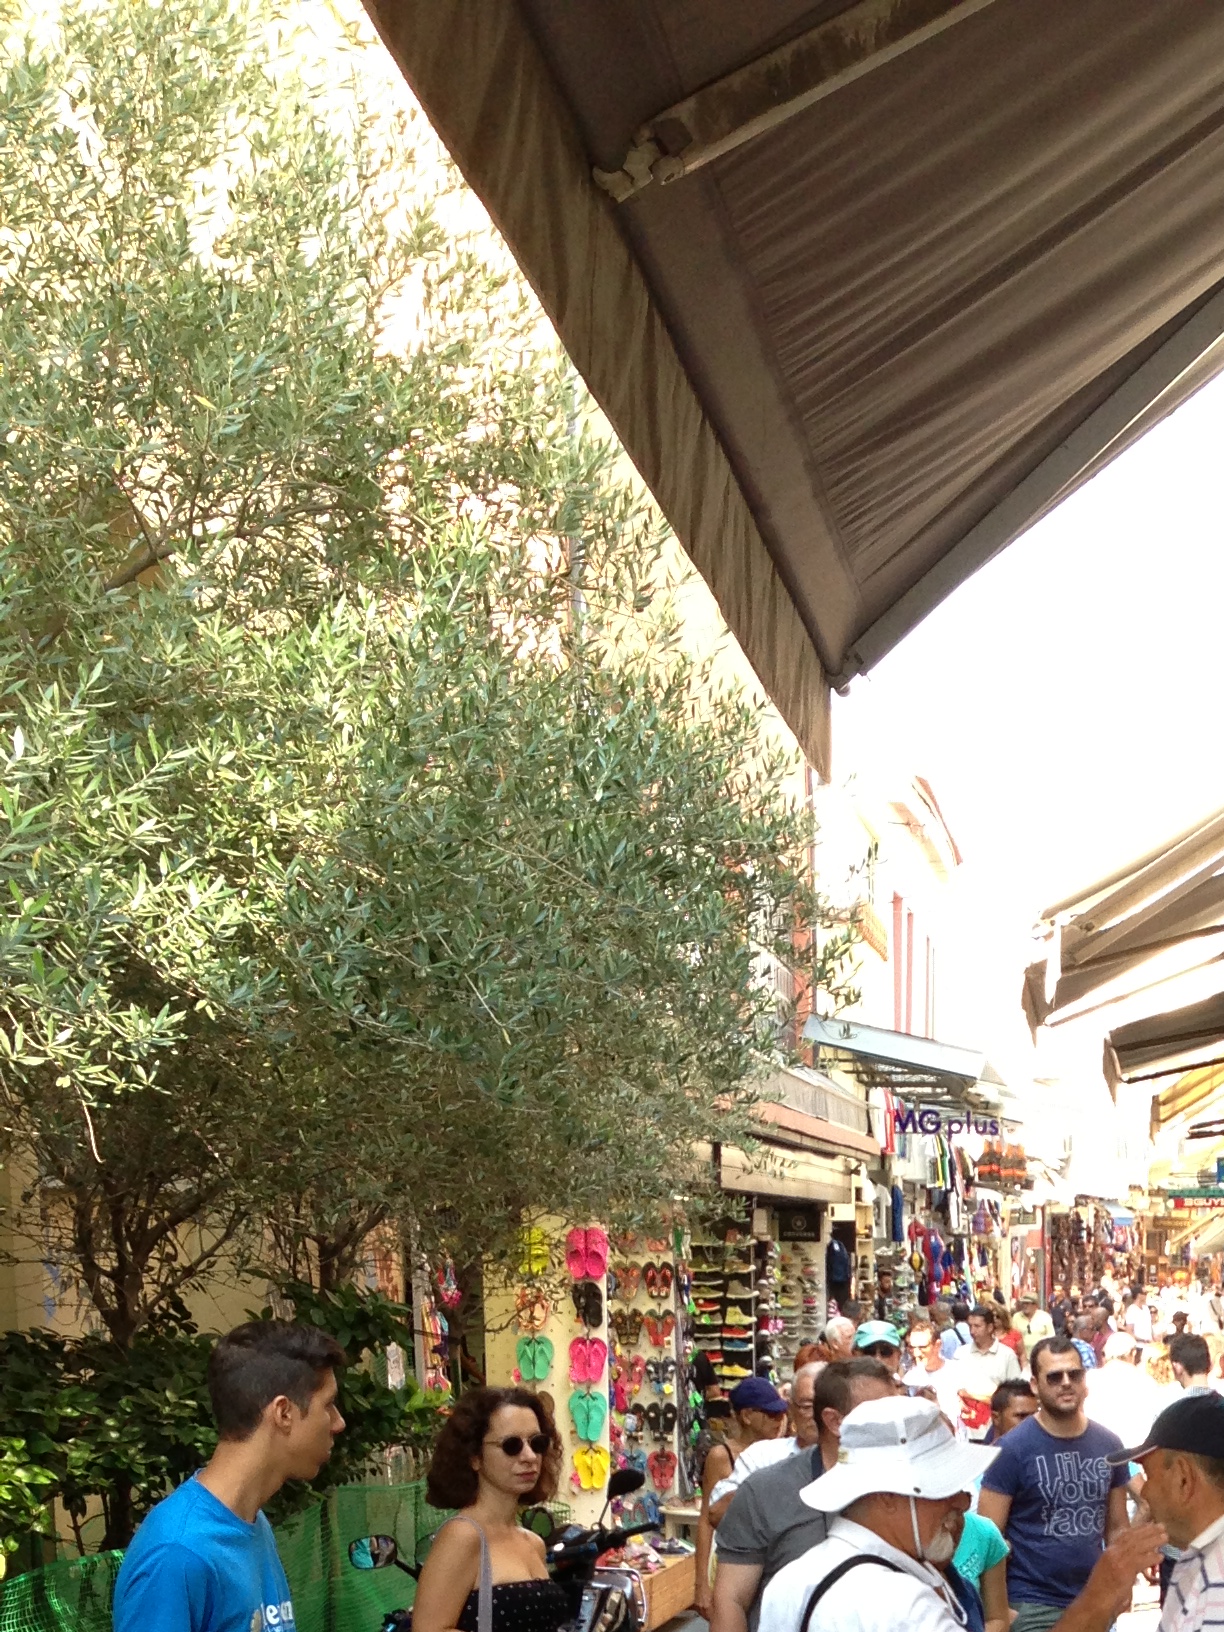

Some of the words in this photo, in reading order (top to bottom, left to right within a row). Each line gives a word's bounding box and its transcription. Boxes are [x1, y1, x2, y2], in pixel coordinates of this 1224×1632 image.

[894, 1109, 942, 1135] MG
[947, 1109, 999, 1144] plus
[1054, 1451, 1112, 1483] like
